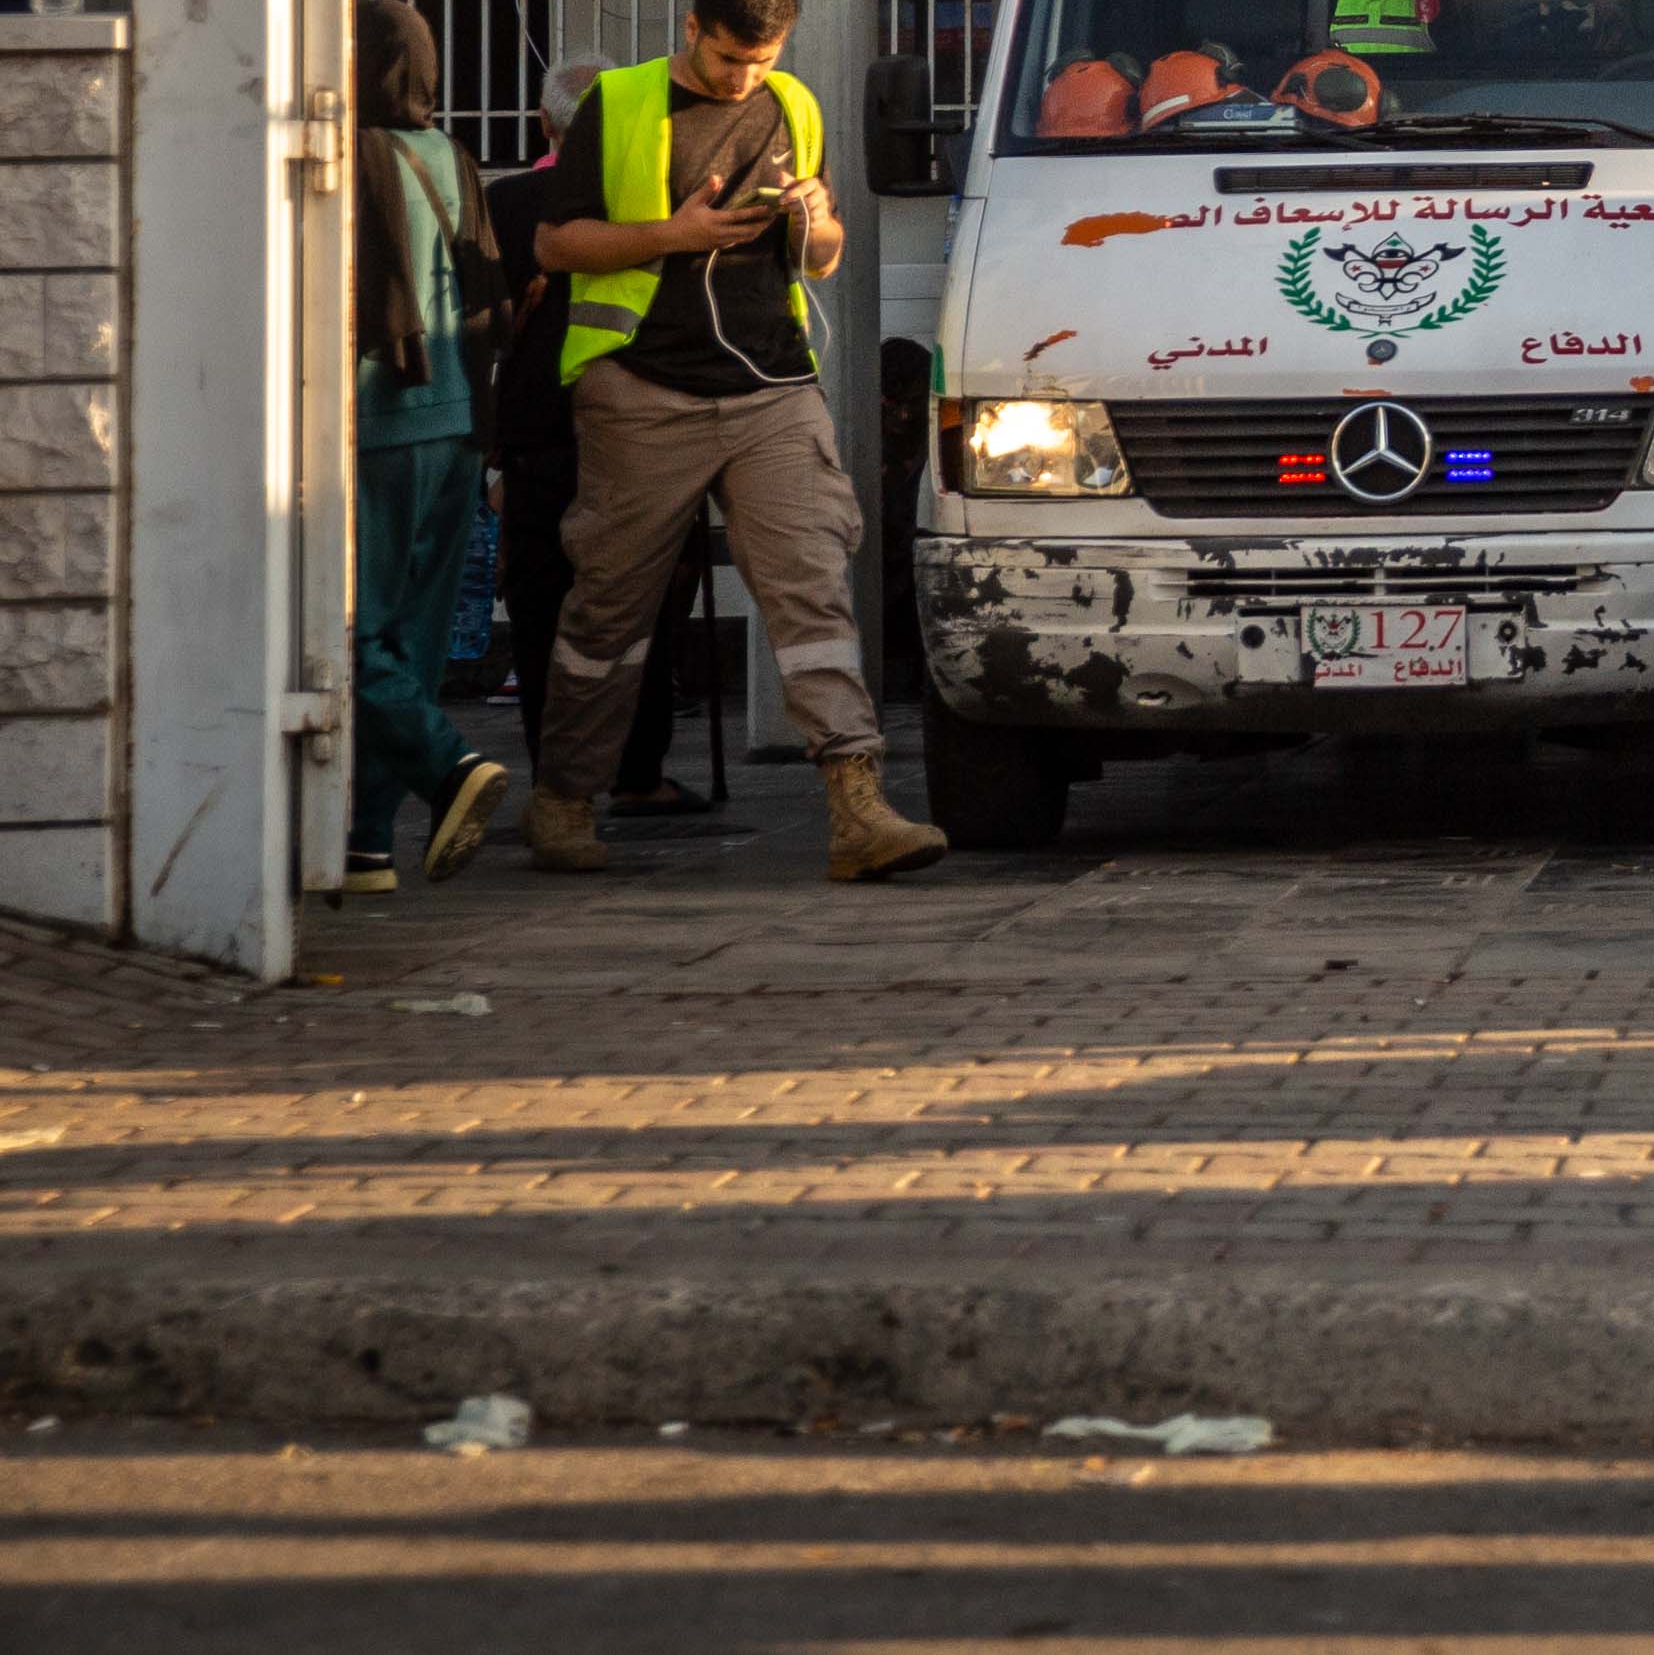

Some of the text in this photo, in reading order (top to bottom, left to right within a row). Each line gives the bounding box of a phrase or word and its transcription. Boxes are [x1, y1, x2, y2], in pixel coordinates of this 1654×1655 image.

[1233, 196, 1401, 232] للإسعاف
[1412, 197, 1569, 228] الرسالة
[1146, 333, 1643, 371] الدفاع المدني
[1370, 609, 1464, 650] 127
[1393, 657, 1463, 683] الدفاع
